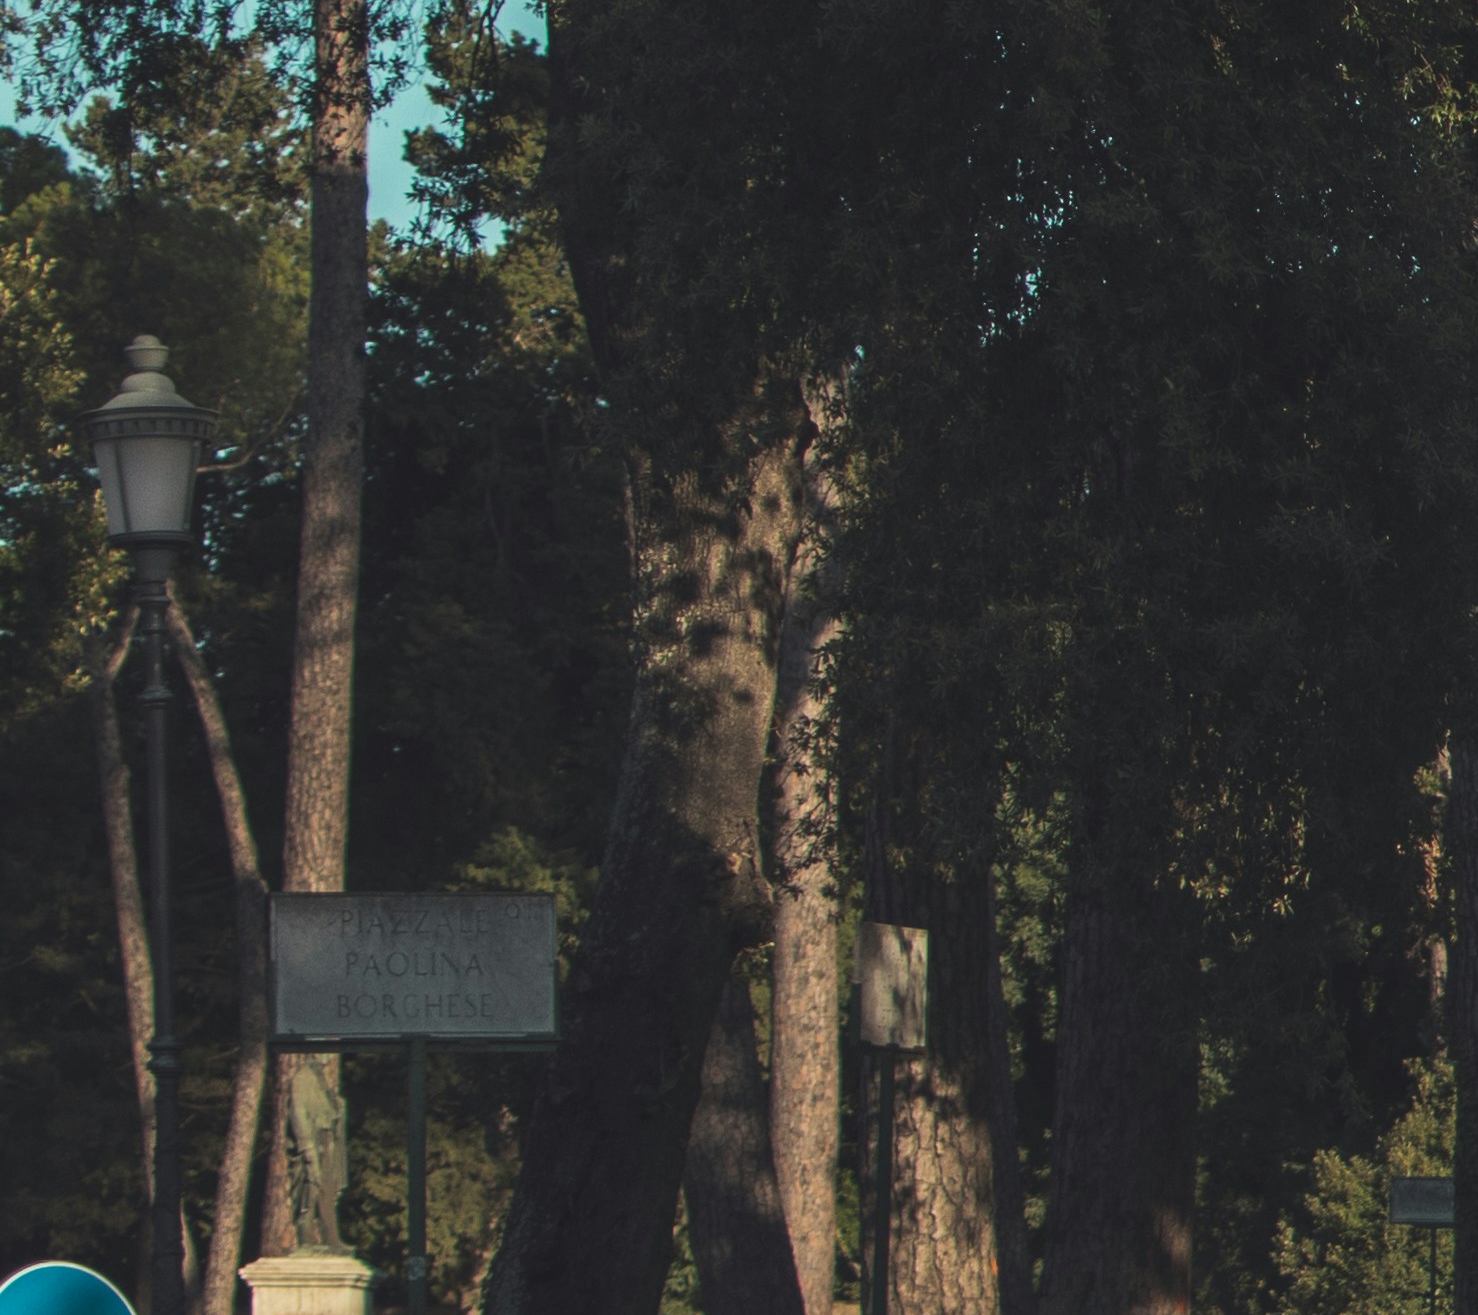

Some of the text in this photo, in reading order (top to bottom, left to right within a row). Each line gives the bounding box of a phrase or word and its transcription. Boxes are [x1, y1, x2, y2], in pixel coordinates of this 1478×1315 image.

[340, 908, 489, 936] PIAZZALE
[344, 951, 485, 977] PAOLINA
[335, 993, 493, 1020] BORGHESE
